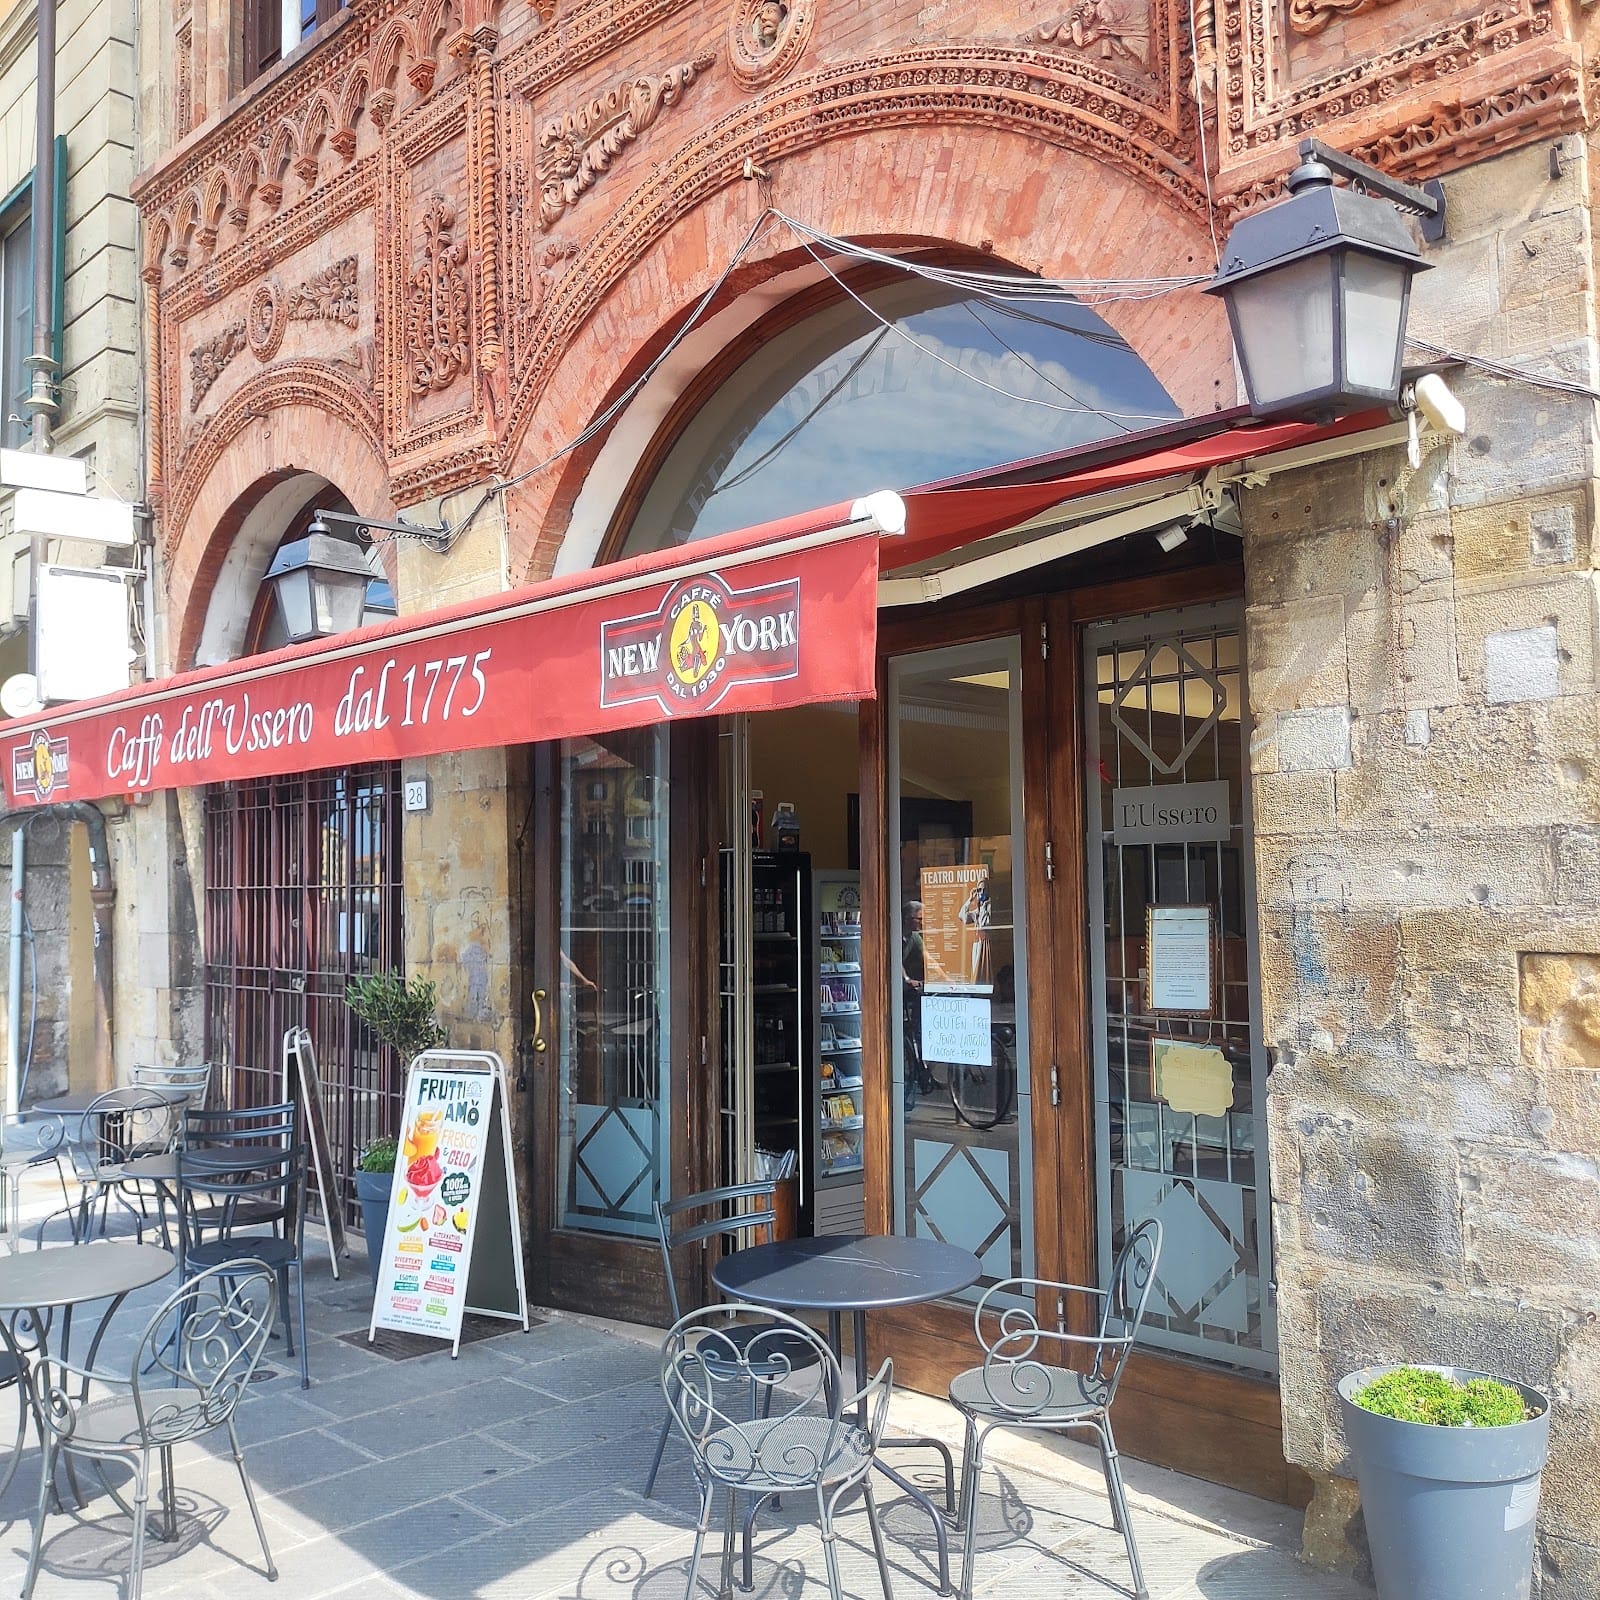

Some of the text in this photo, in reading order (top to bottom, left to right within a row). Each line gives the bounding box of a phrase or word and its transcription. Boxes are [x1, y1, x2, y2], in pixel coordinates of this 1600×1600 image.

[608, 610, 798, 680] NEW YORK
[665, 656, 727, 699] DAL 1930
[170, 692, 315, 765] dell'Ussero
[334, 658, 396, 737] dal
[400, 647, 493, 727] 1775
[16, 751, 68, 780] NEW YORK
[408, 786, 423, 805] 28
[923, 869, 989, 885] TEATRO NUOVO
[933, 1015, 967, 1030] GLUTEN
[417, 1078, 466, 1105] FRUTTI
[441, 1128, 477, 1149] FRESCO
[447, 1150, 471, 1168] GELO
[445, 1178, 467, 1192] 100%
